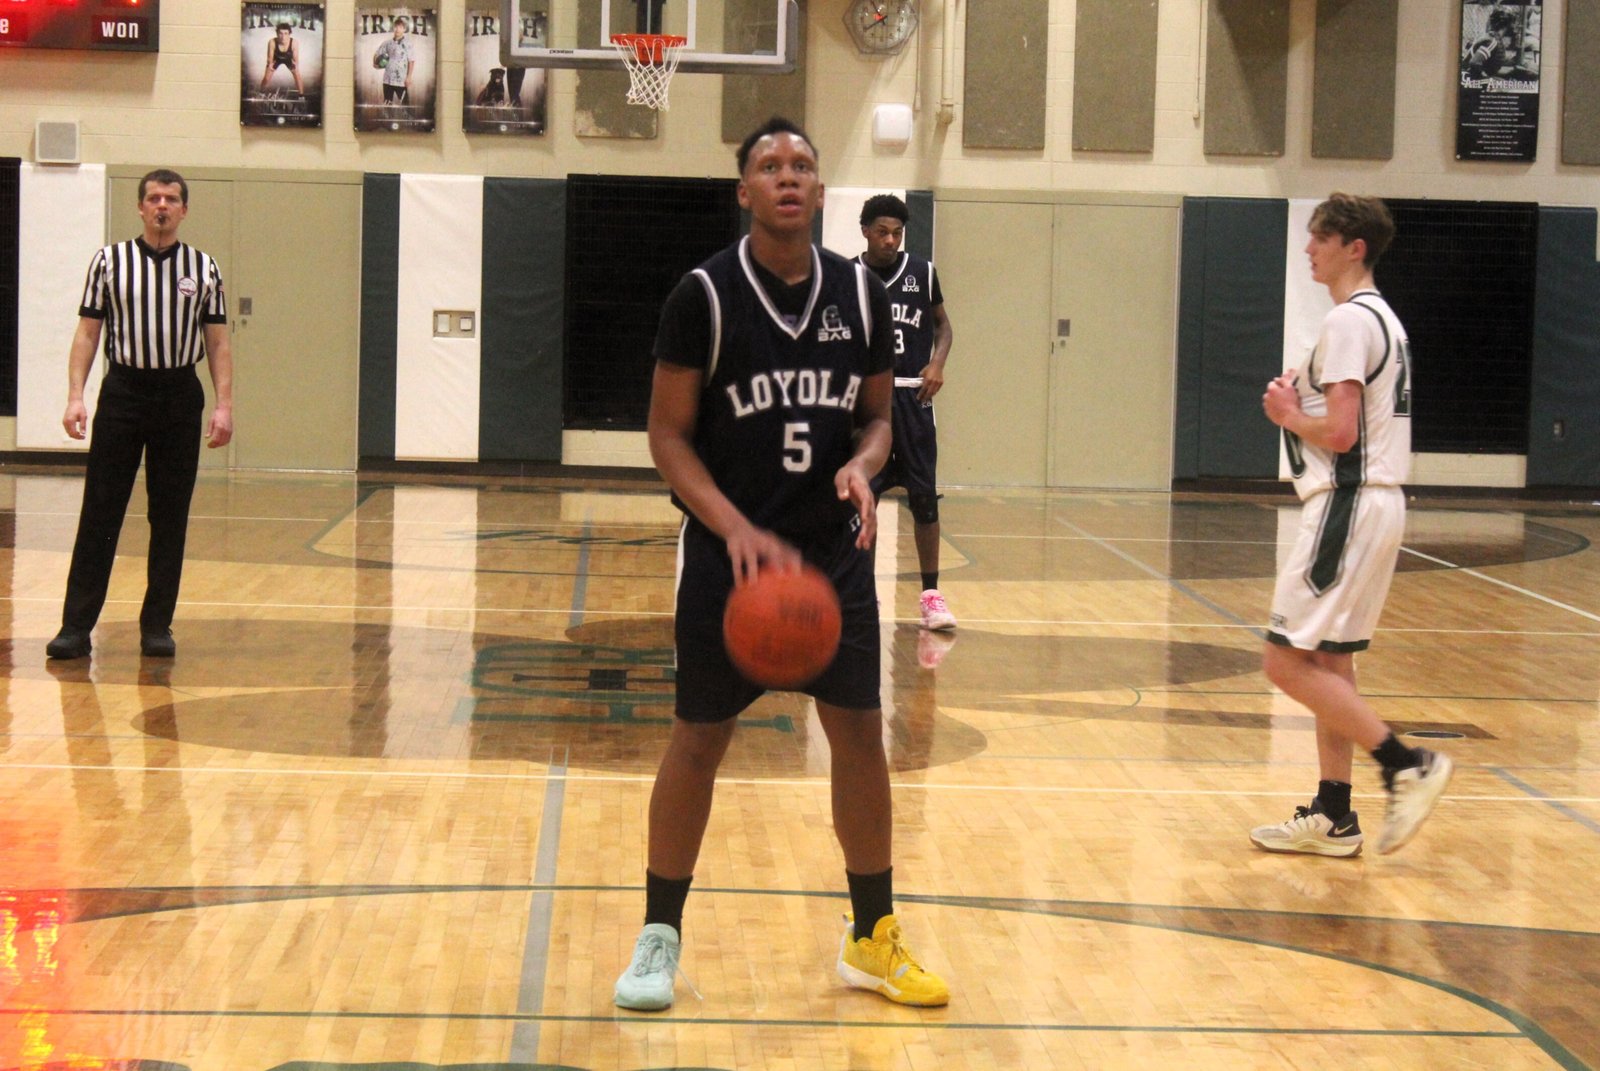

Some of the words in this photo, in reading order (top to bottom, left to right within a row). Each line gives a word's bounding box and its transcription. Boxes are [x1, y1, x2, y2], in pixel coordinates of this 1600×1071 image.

[101, 21, 139, 39] won
[361, 14, 428, 36] IRISH
[471, 15, 538, 39] IRH
[891, 303, 923, 329] OLA
[727, 369, 862, 418] LOYOLA
[782, 422, 813, 474] 5
